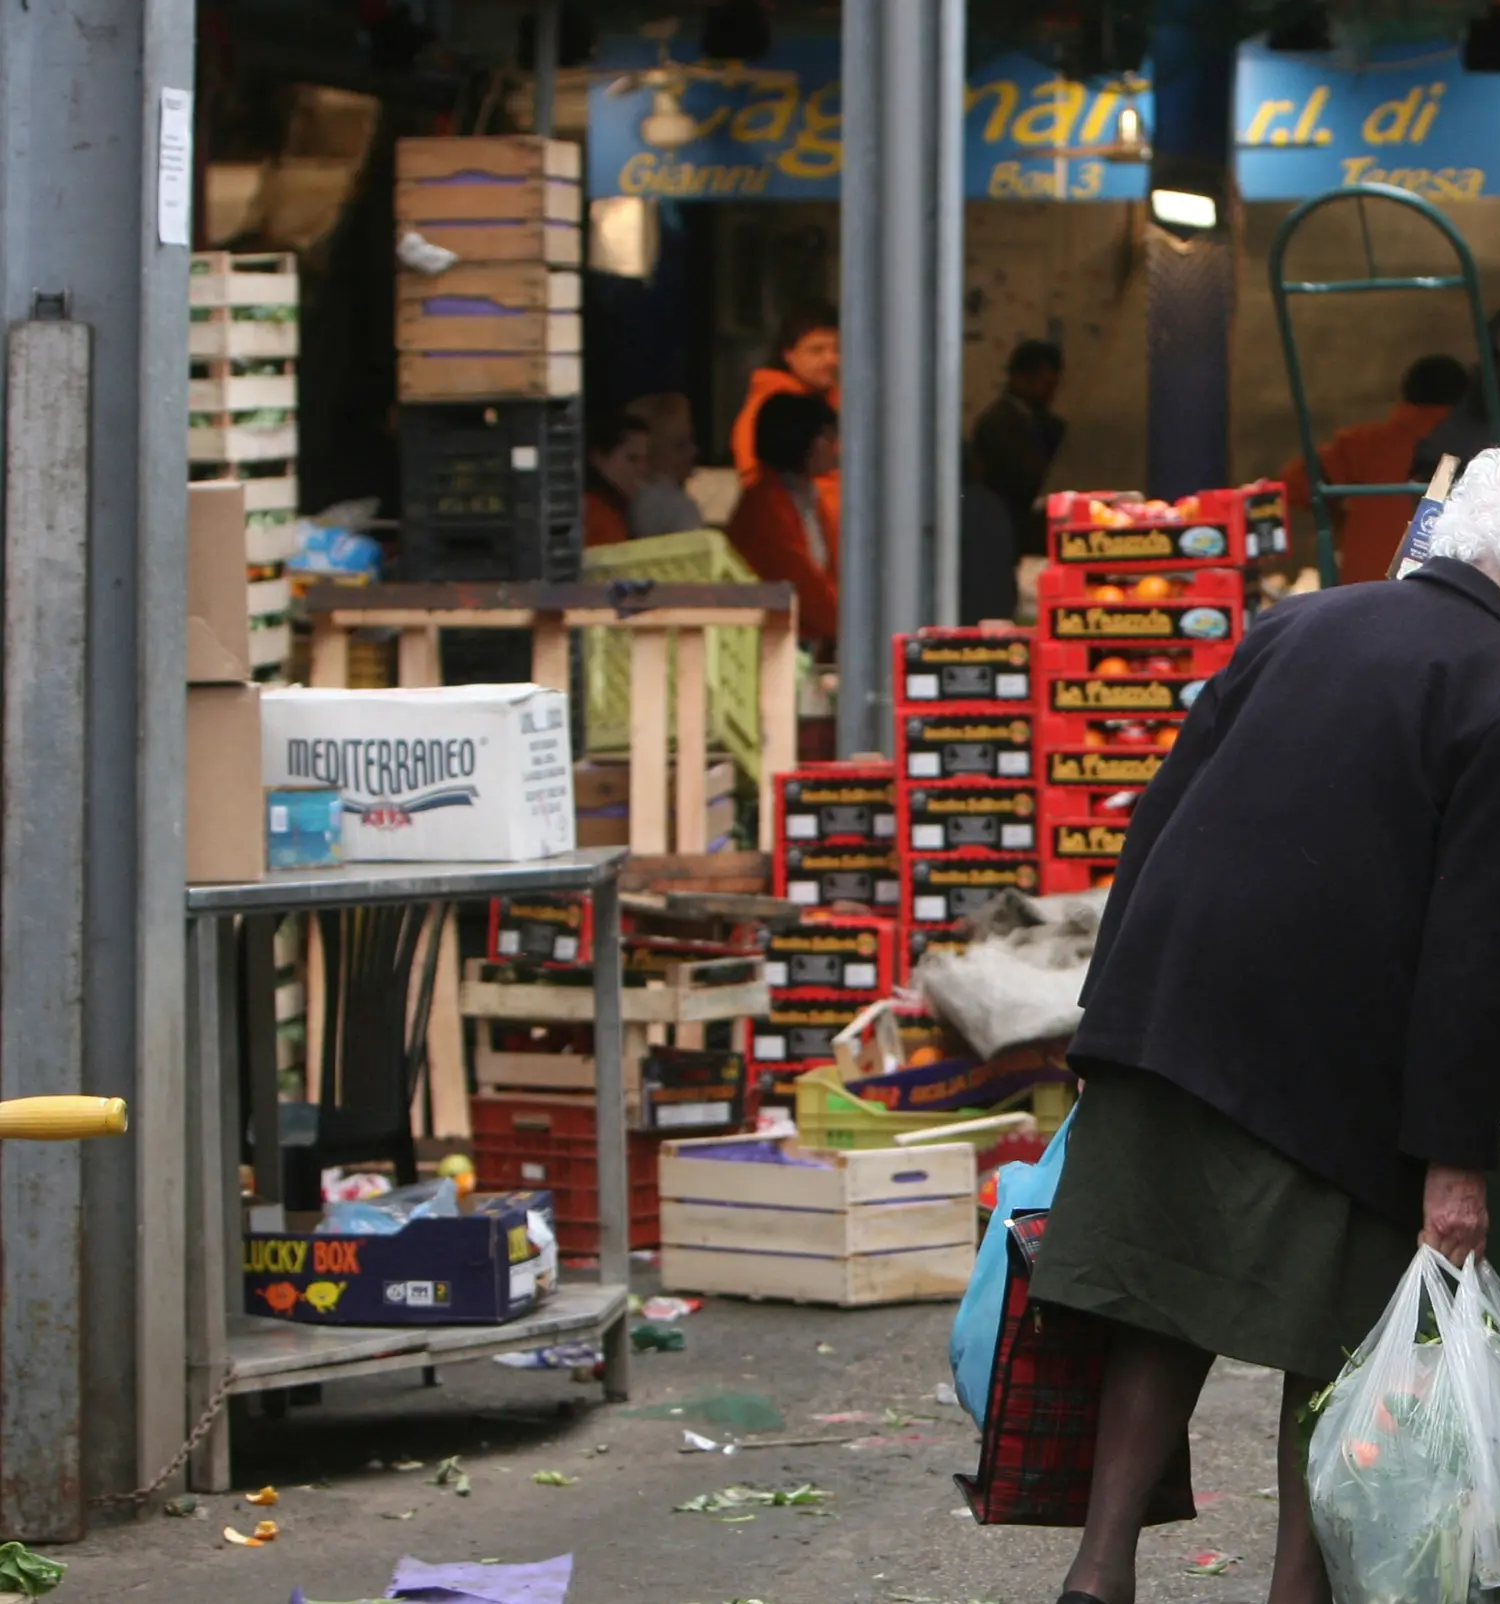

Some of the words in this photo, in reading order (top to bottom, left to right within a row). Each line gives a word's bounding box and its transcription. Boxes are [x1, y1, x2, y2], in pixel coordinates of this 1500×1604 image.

[1363, 83, 1446, 144] di
[1073, 163, 1103, 198] 3
[288, 738, 475, 796] MEDITERRANEO
[313, 1240, 360, 1274] BOX
